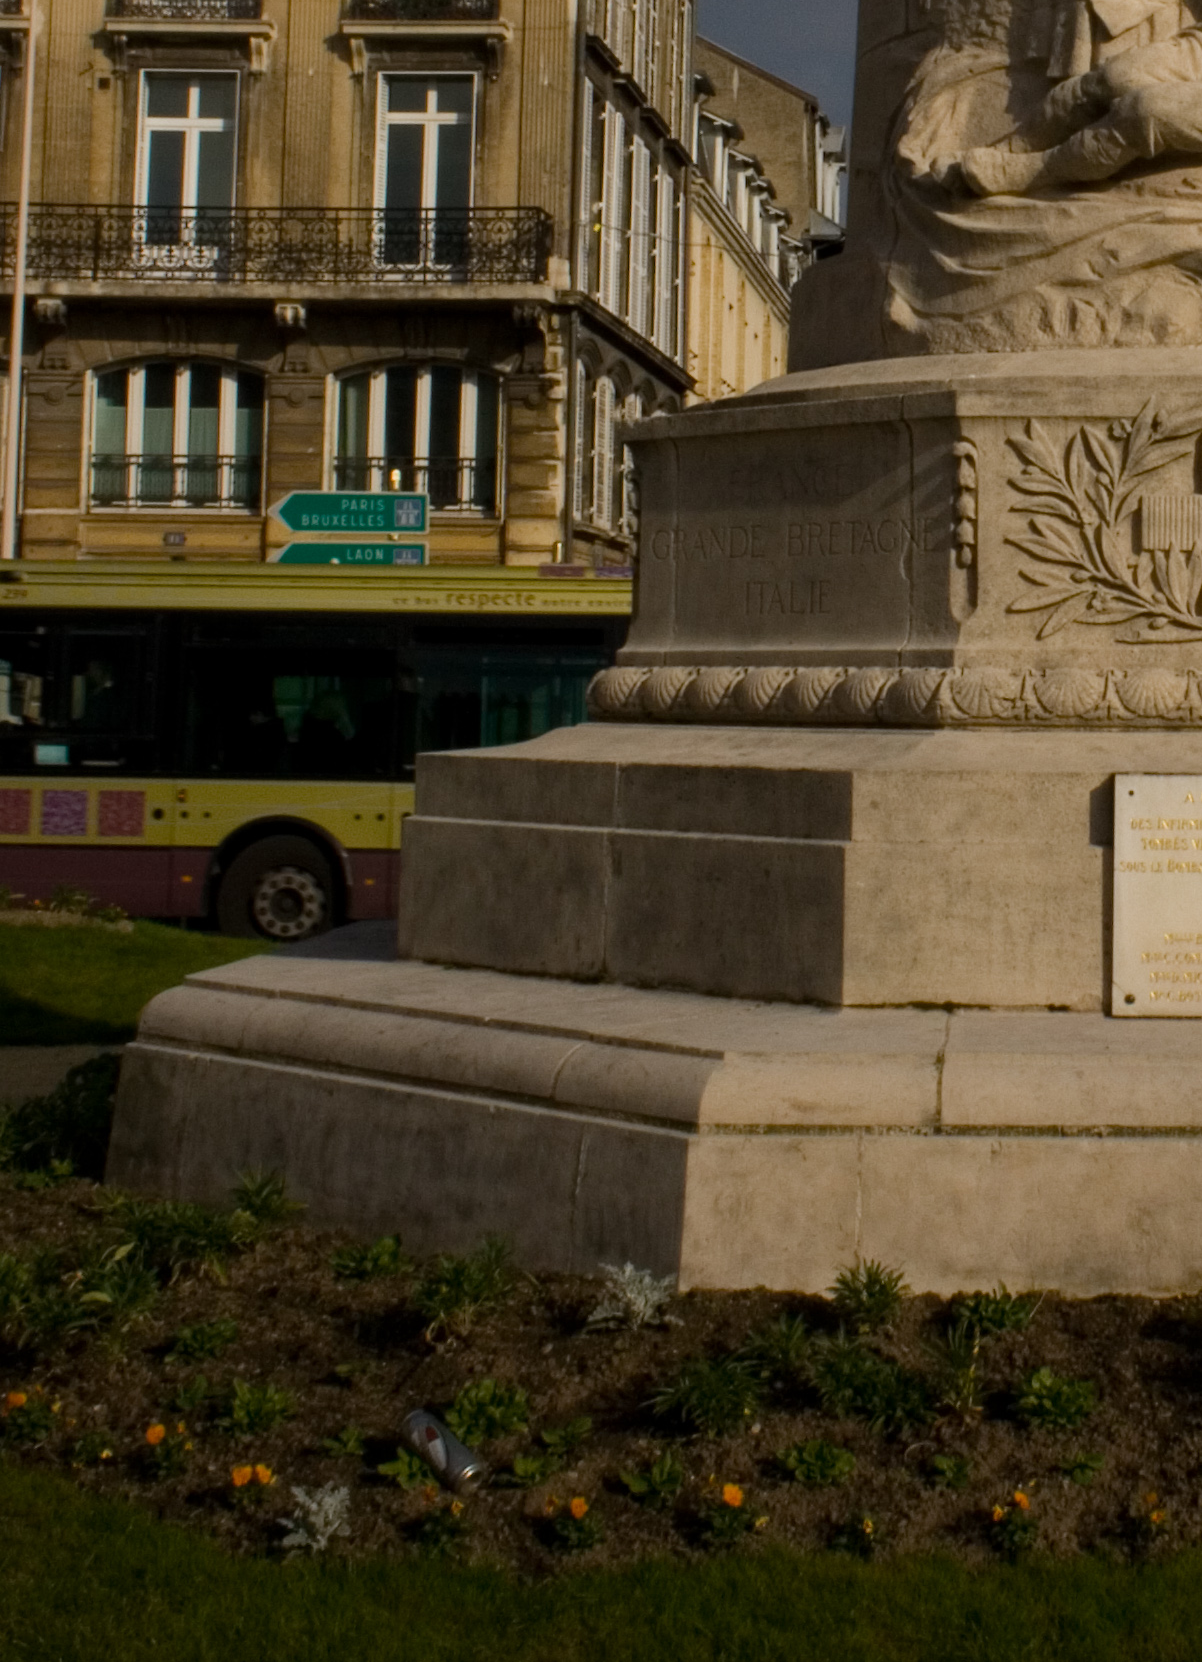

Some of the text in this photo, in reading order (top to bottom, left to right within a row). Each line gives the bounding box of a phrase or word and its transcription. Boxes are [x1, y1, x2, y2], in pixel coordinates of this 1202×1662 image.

[728, 464, 856, 500] FRANCE
[341, 498, 385, 512] PARIS
[301, 514, 385, 527] BRUXELLES
[650, 516, 938, 562] GRANDE BRETAGNE
[346, 548, 385, 561] LAON
[445, 591, 536, 610] respecte
[745, 578, 832, 616] ITALIE
[1184, 790, 1196, 805] A
[1131, 818, 1153, 832] DES
[1119, 860, 1147, 873] SOUS
[1150, 861, 1163, 873] LE
